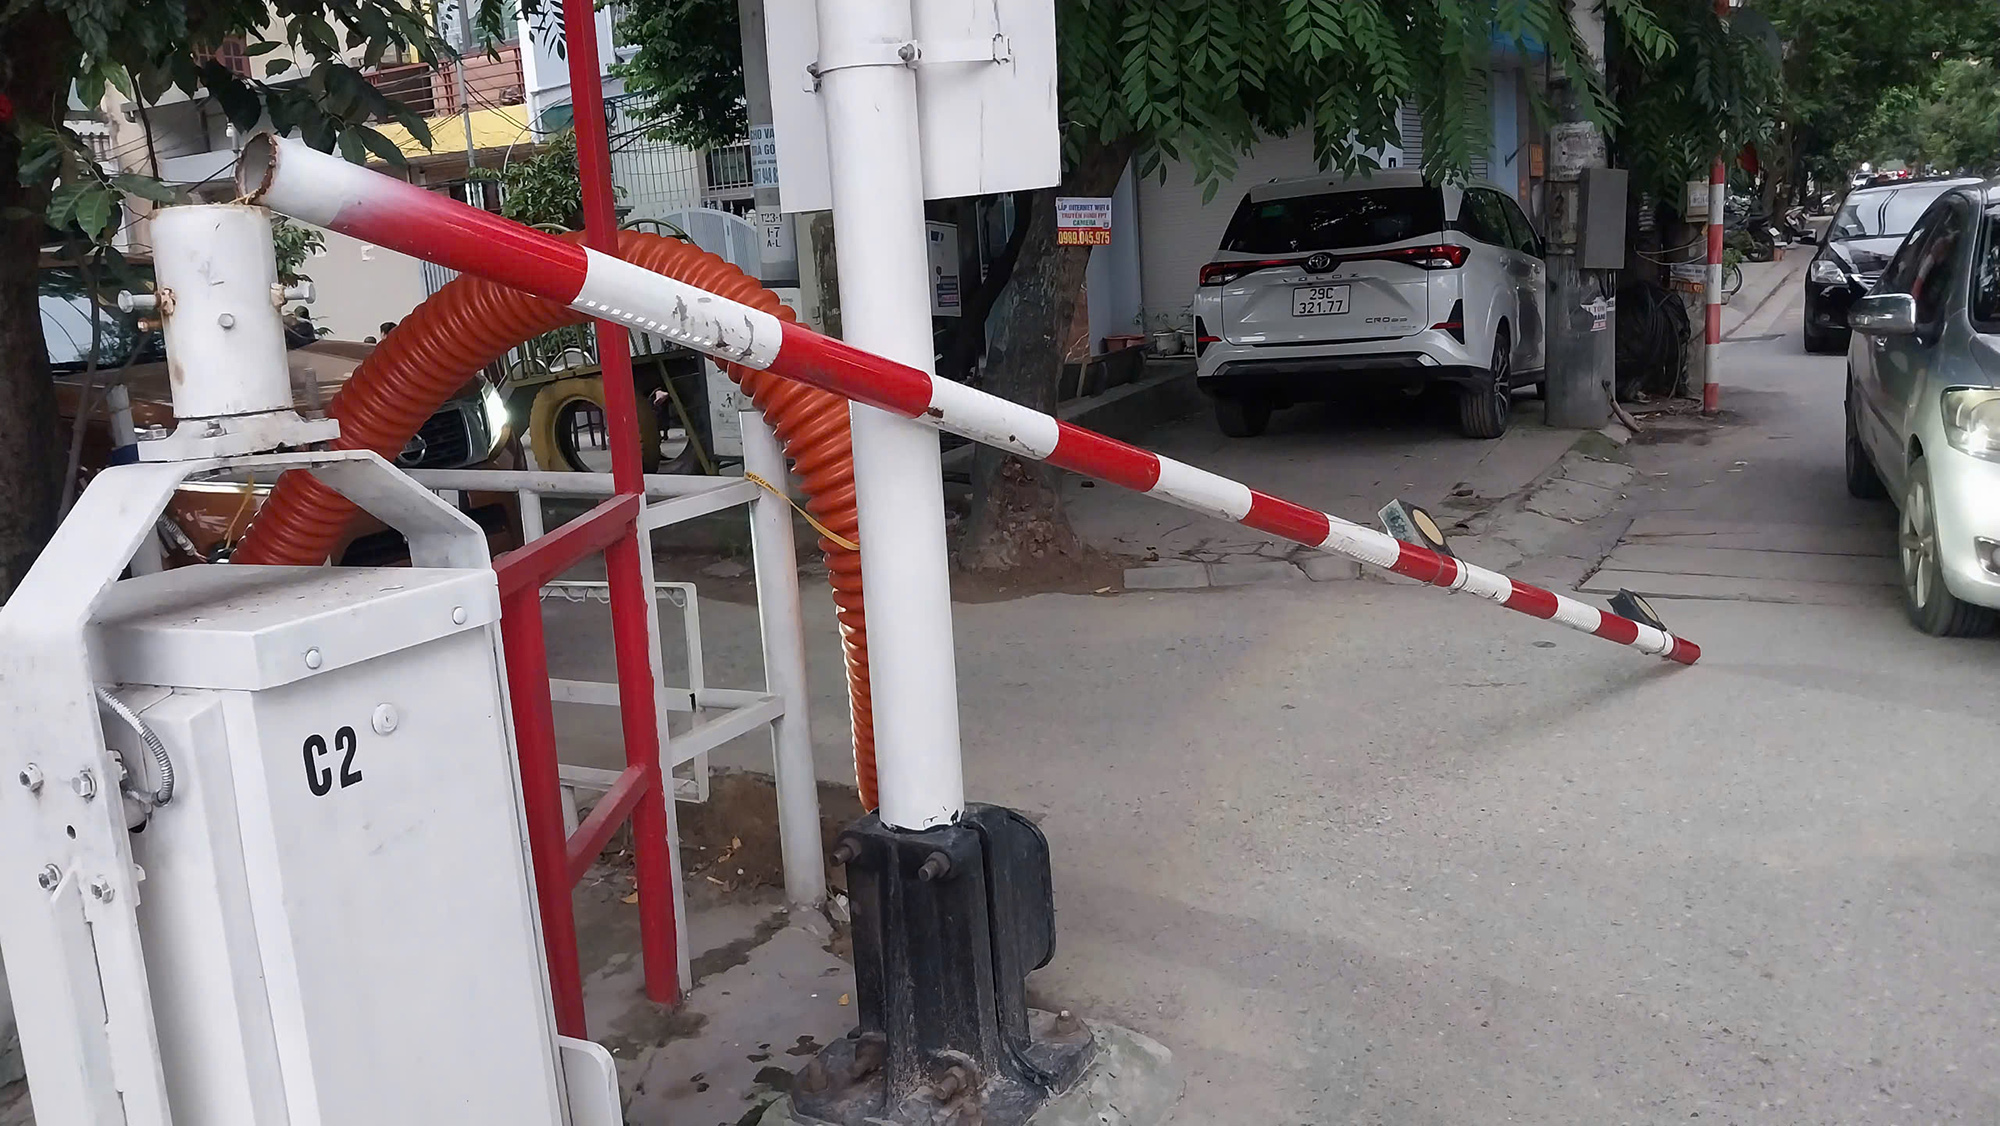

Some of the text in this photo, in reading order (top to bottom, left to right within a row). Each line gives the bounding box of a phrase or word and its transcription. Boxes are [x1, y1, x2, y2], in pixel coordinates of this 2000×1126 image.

[764, 128, 775, 139] VA
[764, 141, 776, 155] GÓ
[1058, 230, 1110, 245] 0989.045.975
[1309, 287, 1334, 301] 29C
[1298, 300, 1343, 314] 321.77
[303, 725, 363, 797] C2
